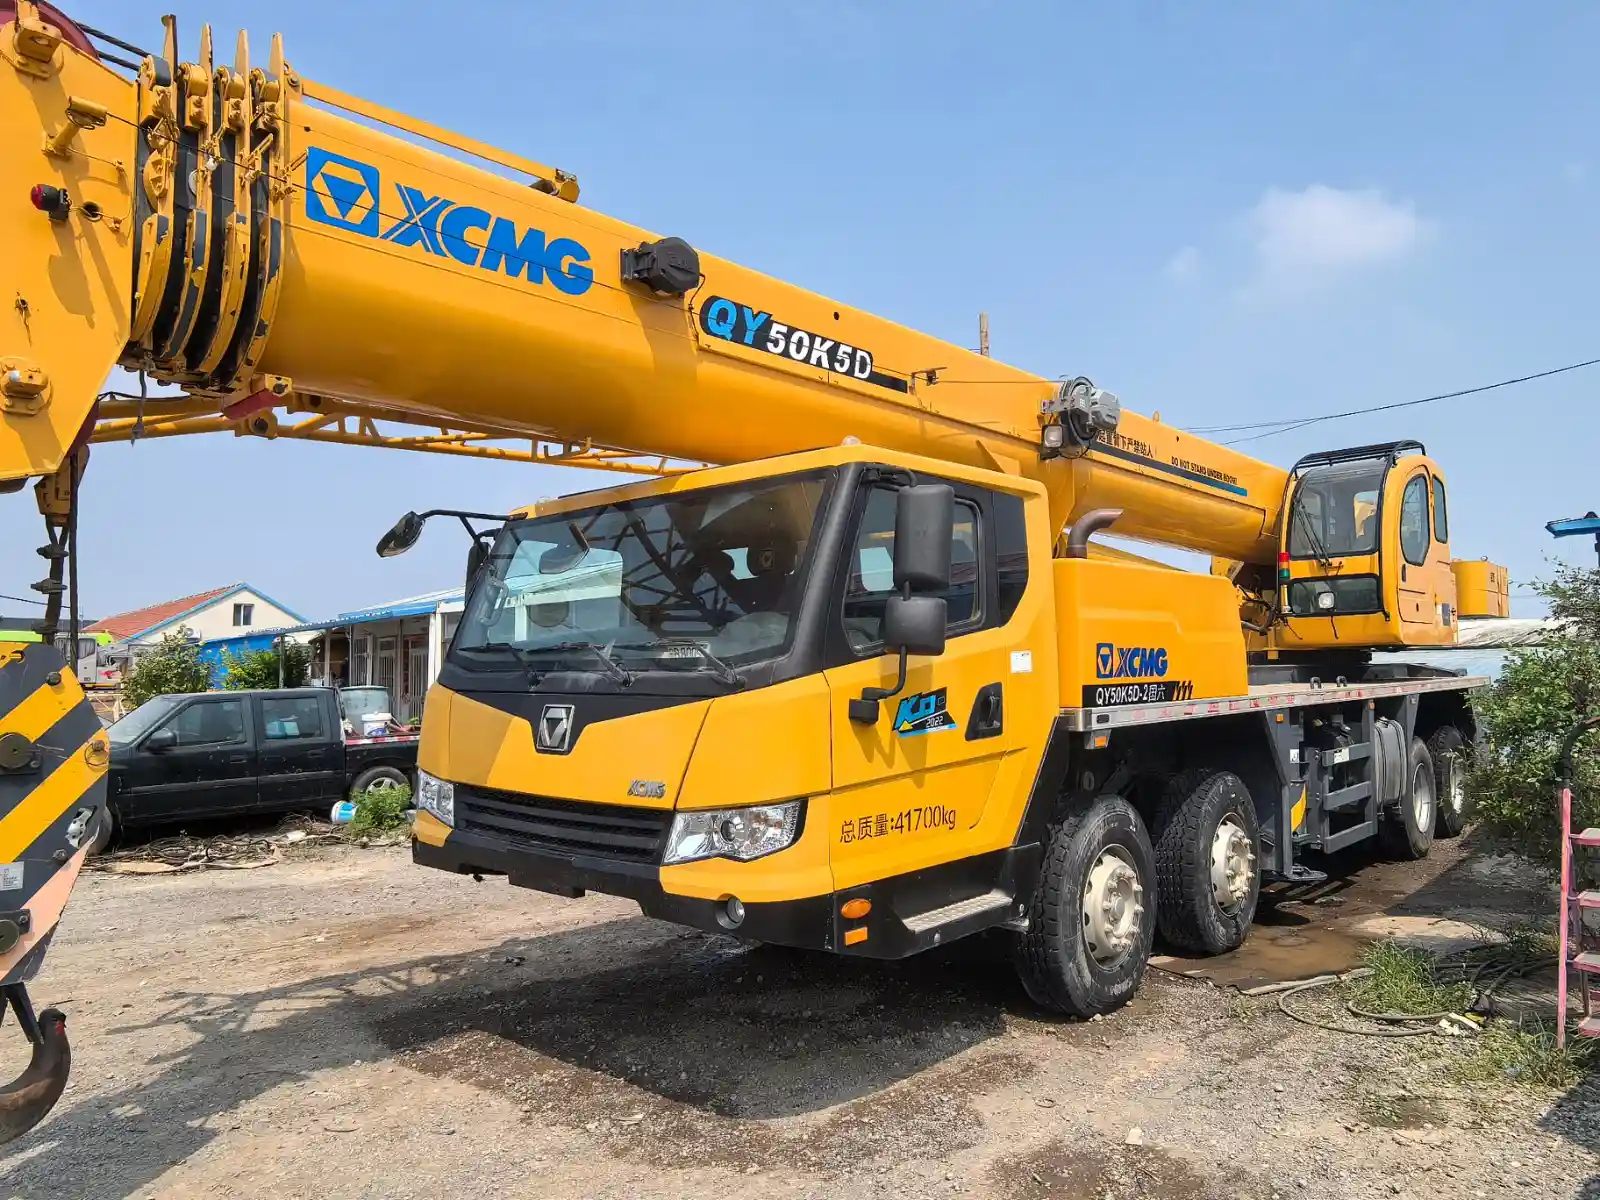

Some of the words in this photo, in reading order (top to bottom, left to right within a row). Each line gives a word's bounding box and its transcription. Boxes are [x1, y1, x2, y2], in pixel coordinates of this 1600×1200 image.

[379, 182, 593, 296] XCMG
[707, 298, 872, 379] QY50K5D
[1171, 456, 1179, 466] DO
[1180, 458, 1190, 470] NOT
[1191, 462, 1207, 475] STAND
[1207, 467, 1222, 480] UNDER
[1114, 647, 1168, 678] XCMG
[926, 715, 944, 728] 2022
